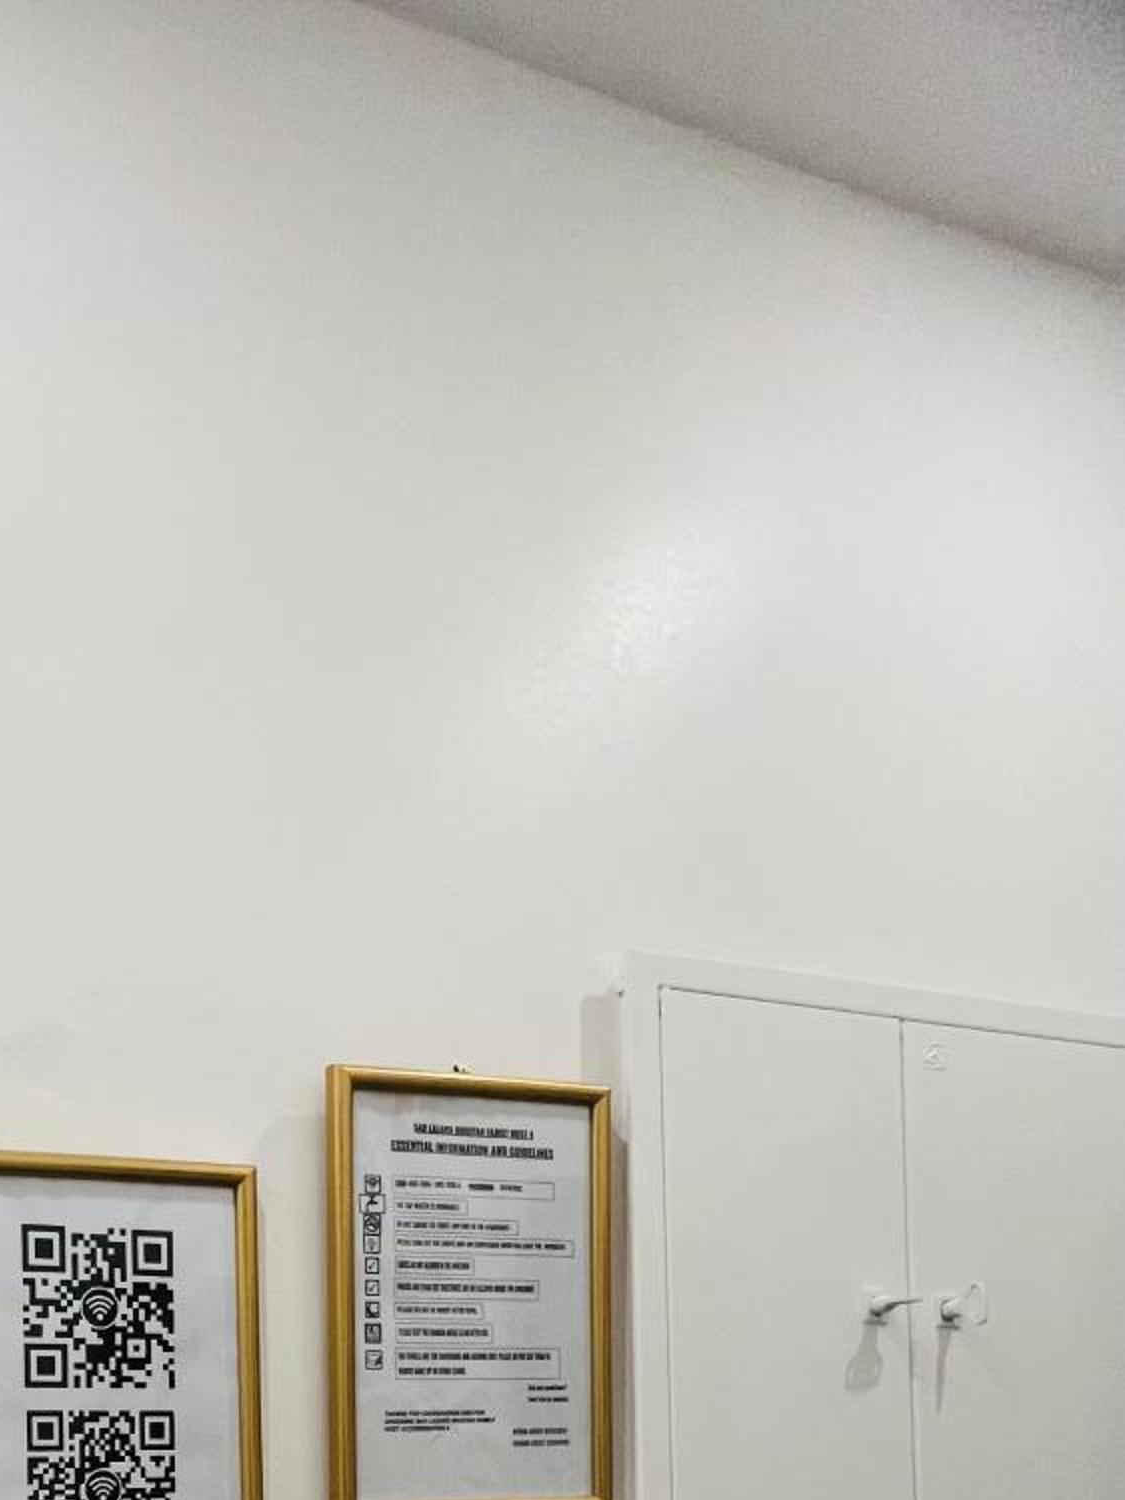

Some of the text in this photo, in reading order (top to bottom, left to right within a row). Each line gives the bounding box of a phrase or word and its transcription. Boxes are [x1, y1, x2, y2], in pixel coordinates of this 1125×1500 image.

[390, 1138, 554, 1161] ESSENTIAL INFORMATION AND GUIDELINES
